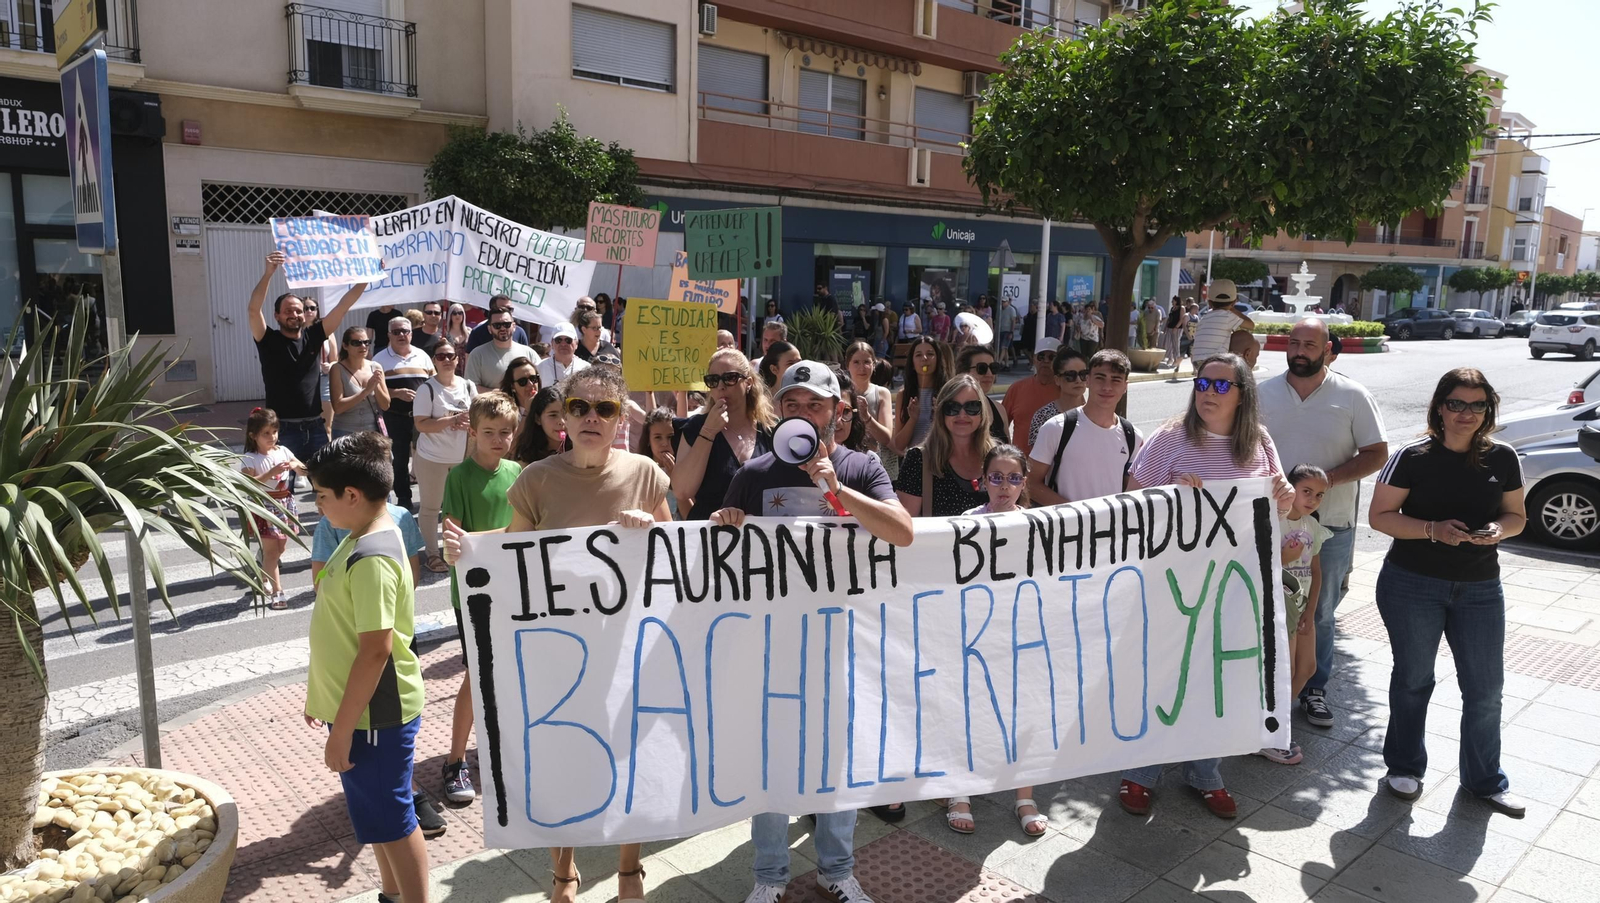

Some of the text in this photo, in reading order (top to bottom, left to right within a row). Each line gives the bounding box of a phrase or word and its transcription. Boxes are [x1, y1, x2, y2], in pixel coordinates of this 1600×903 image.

[180, 217, 200, 225] VENDE
[621, 210, 656, 229] FUTURO
[689, 213, 749, 229] APRENDER
[435, 199, 456, 230] EN
[461, 204, 522, 248] NUESTRO
[526, 232, 585, 263] PUEBLO
[590, 225, 644, 247] RECORTES
[707, 234, 724, 247] ES
[947, 228, 975, 243] Unicaja
[277, 238, 369, 257] CALIDAD EN
[378, 229, 465, 260] MBRANDO
[606, 246, 631, 262] ¡NO!
[695, 247, 749, 273] CRECER
[462, 265, 546, 308] PROGRESO
[1003, 285, 1020, 298] 630
[637, 305, 716, 328] ESTUDIAR
[659, 330, 680, 345] ES
[639, 346, 699, 363] NUESTRO
[653, 366, 708, 385] DERECH
[794, 366, 811, 382] S
[644, 522, 897, 608] AURANTIA
